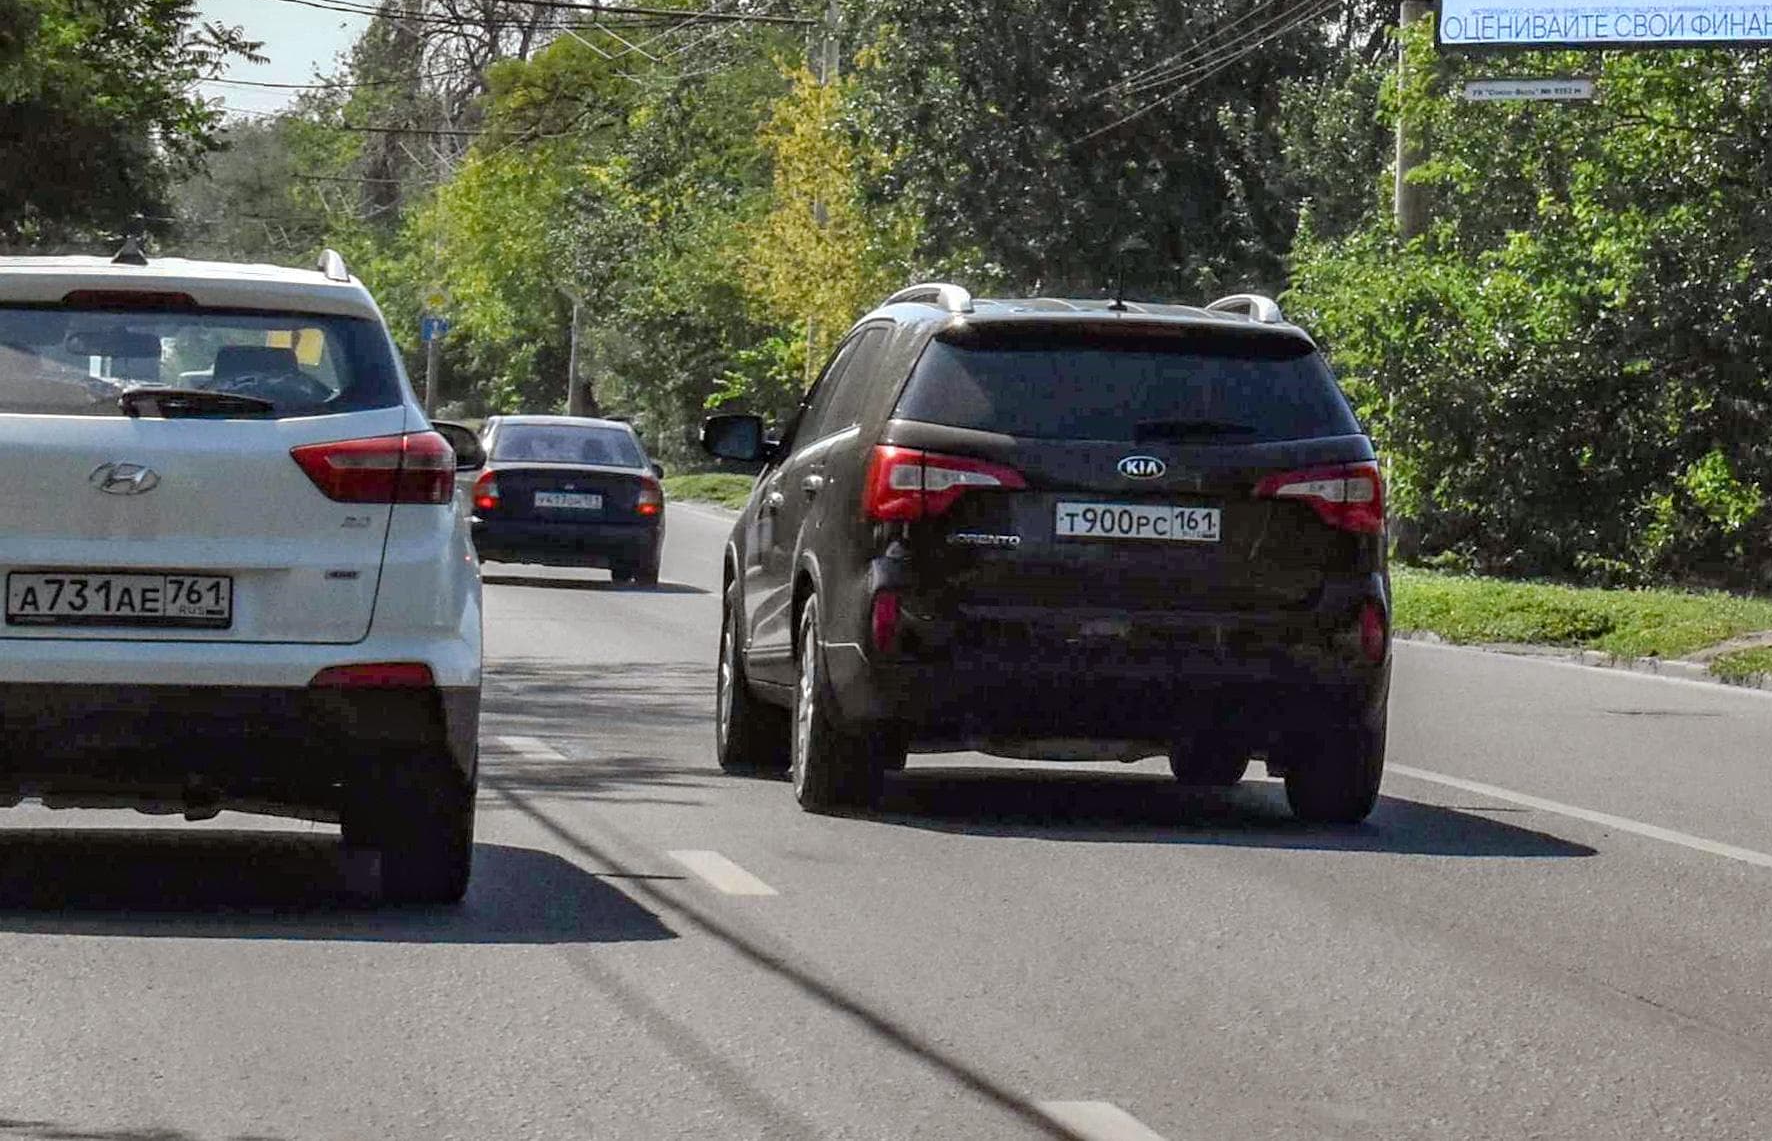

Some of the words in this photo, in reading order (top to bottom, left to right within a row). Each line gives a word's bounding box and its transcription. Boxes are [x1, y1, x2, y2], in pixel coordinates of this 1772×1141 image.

[1444, 13, 1608, 41] ОЦЕНИВАЙТЕ
[1614, 13, 1684, 39] СВОИ
[1125, 460, 1160, 475] KIA
[1065, 508, 1168, 536] Т900РС
[1175, 511, 1212, 531] 161
[19, 578, 161, 613] А731АЕ
[168, 579, 222, 606] 761
